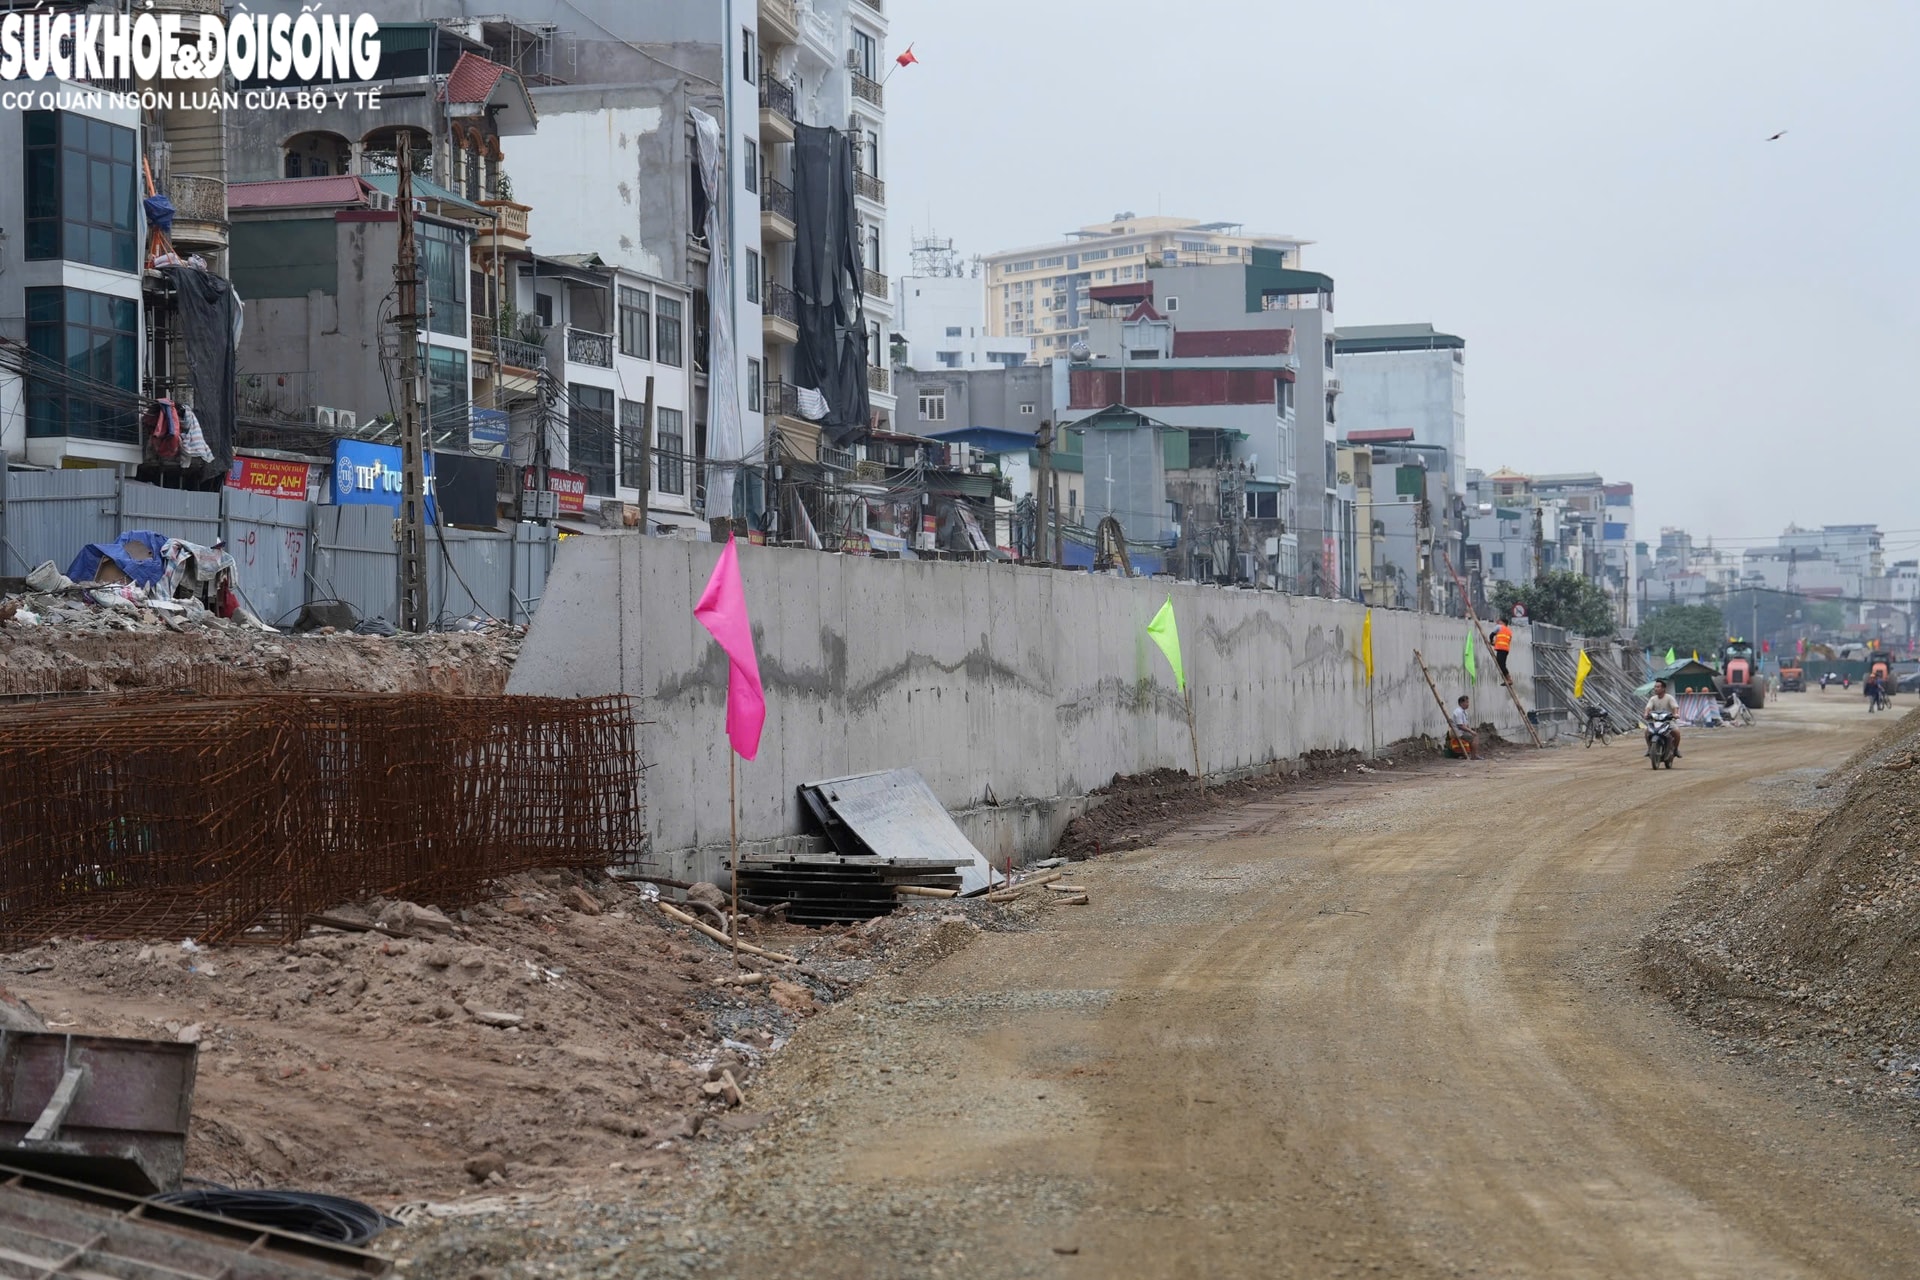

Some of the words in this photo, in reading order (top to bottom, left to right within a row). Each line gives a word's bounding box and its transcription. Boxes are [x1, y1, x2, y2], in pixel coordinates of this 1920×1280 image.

[250, 462, 269, 470] TRUNG
[249, 471, 278, 487] TRÚC
[280, 475, 302, 488] ANH
[356, 466, 375, 490] TH
[550, 477, 572, 493] THANH
[571, 480, 585, 495] SƠN
